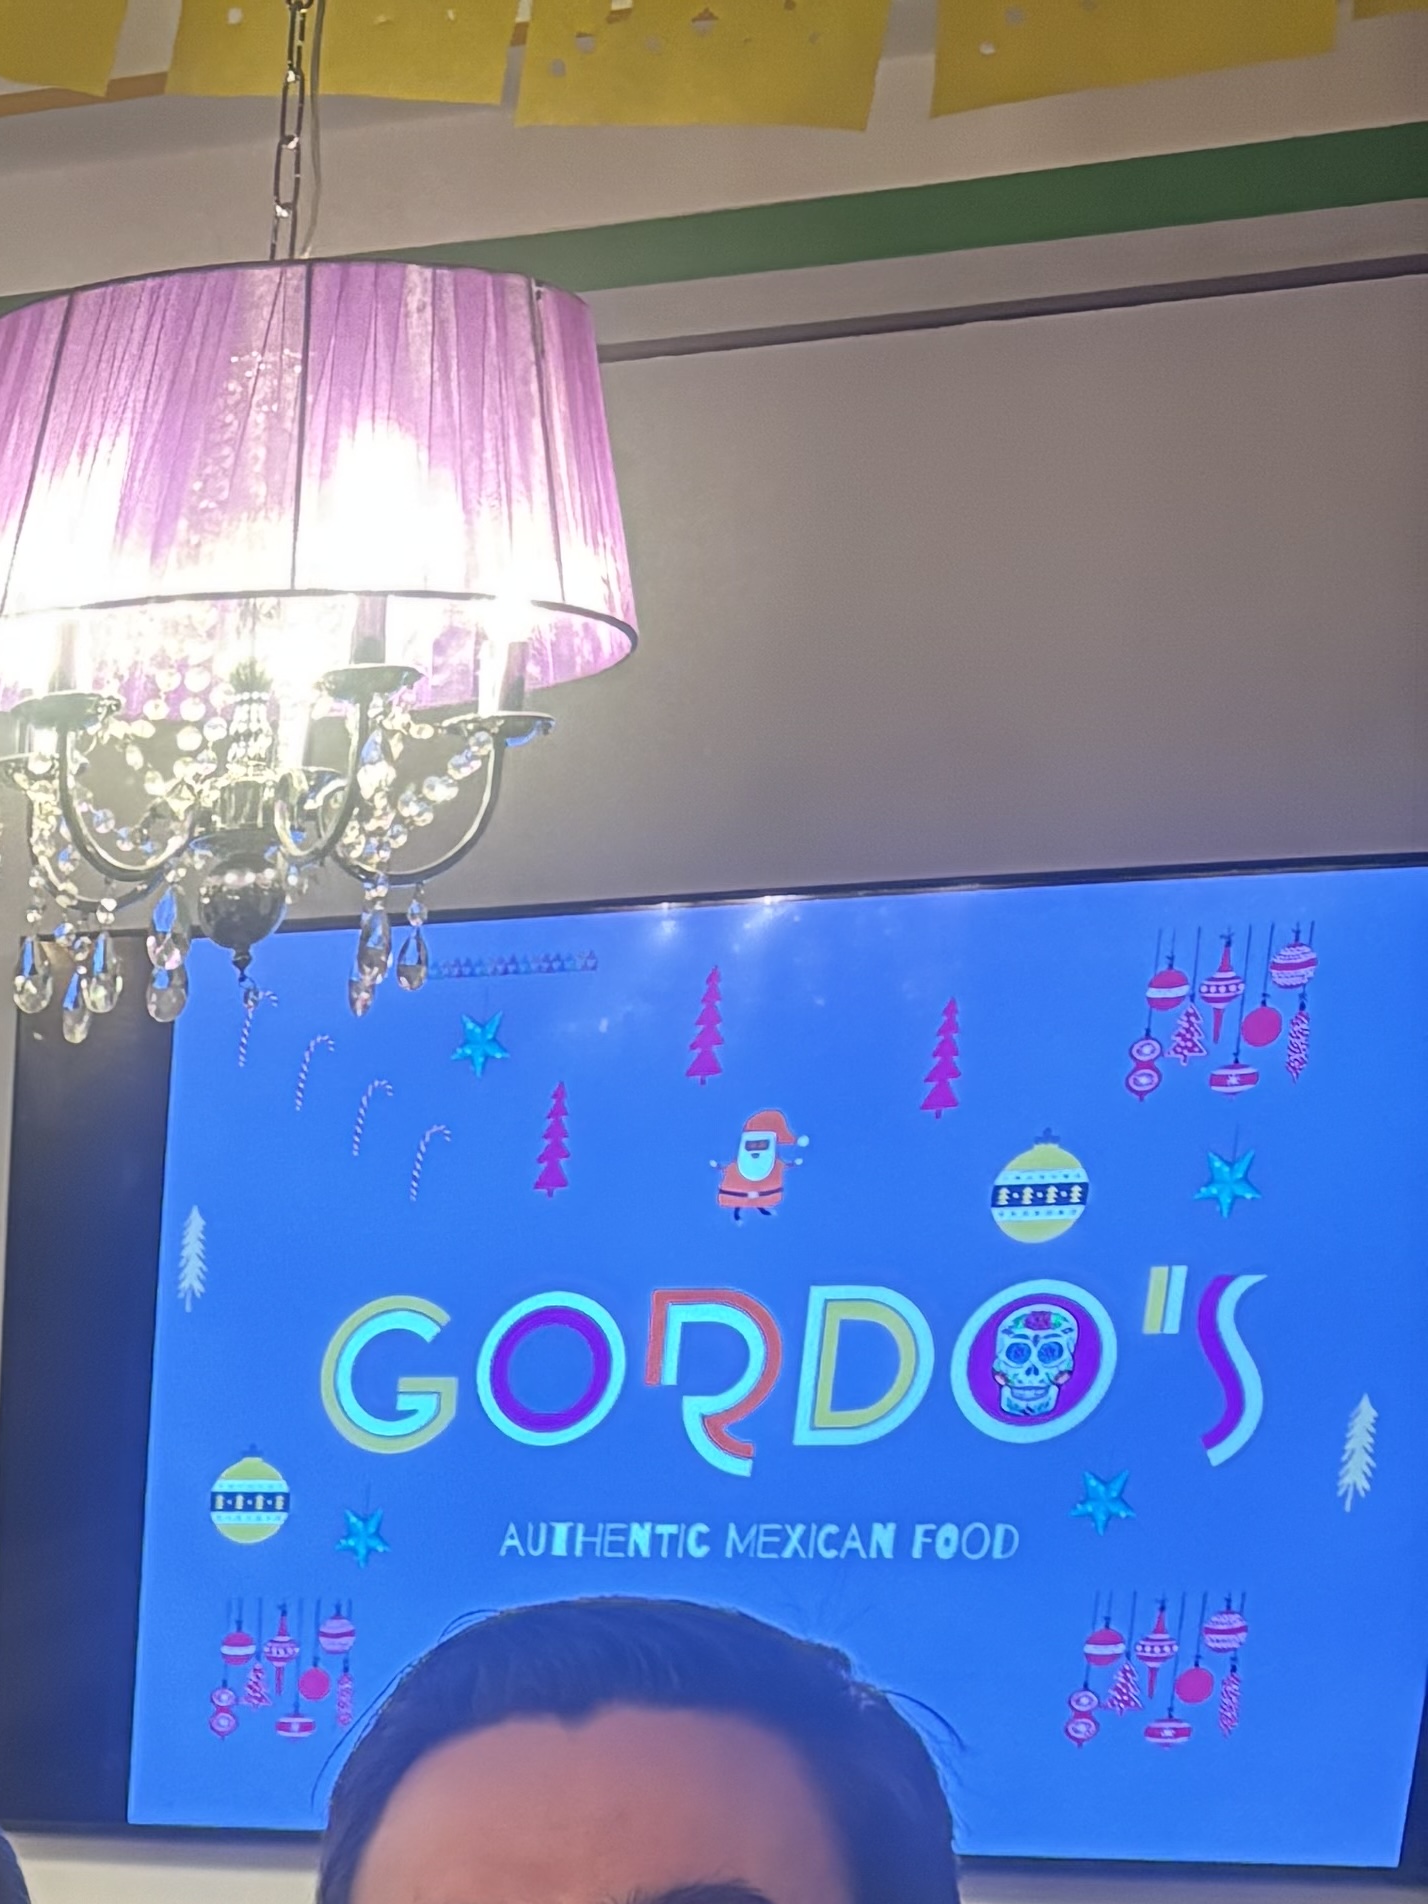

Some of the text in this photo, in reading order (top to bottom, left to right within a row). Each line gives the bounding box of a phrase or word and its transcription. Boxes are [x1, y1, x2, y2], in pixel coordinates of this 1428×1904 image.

[499, 1521, 1020, 1560] AUTHENTIC MEXICAN FOOD
